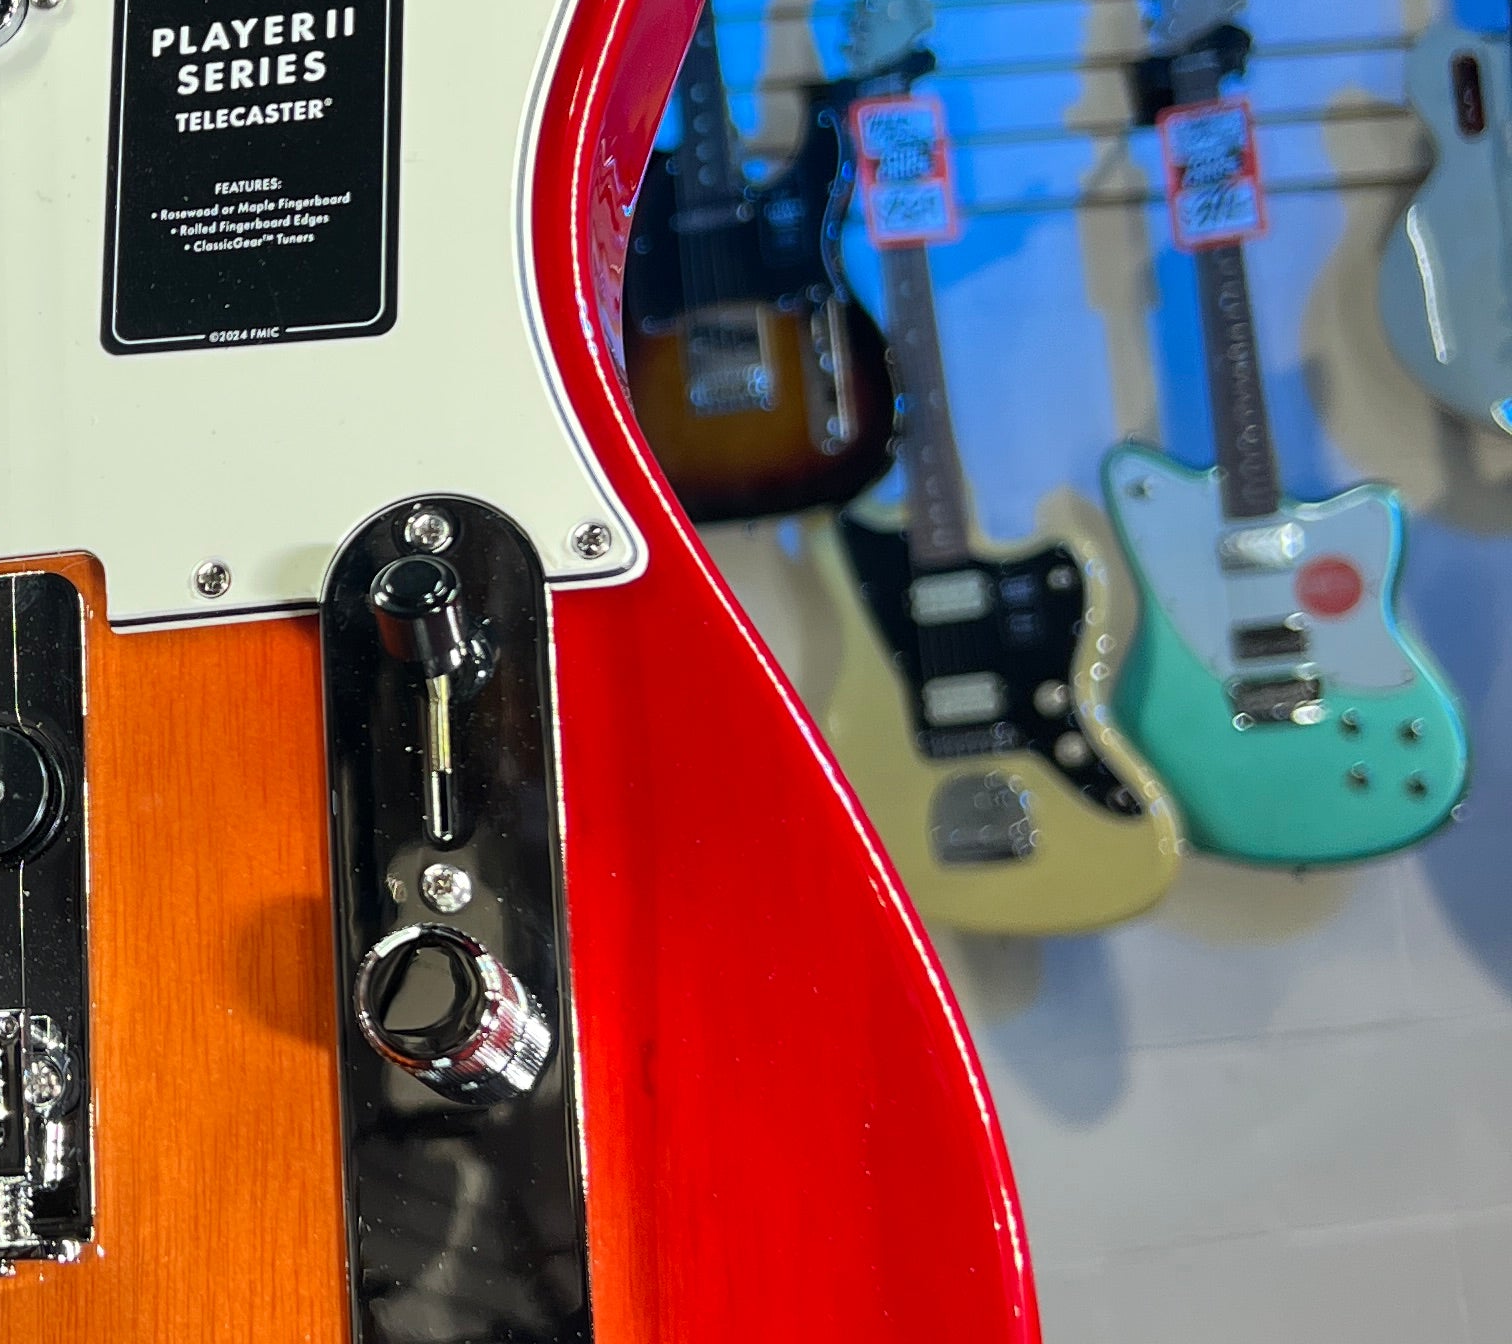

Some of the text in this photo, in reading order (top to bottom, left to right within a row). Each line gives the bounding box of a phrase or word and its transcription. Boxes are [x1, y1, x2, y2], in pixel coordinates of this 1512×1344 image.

[151, 6, 355, 58] PLAYER II
[177, 50, 327, 96] SERIES
[214, 177, 283, 195] FEATURES:
[160, 191, 352, 221] Rosewood or Maple Fingerboard
[179, 213, 330, 237] Rolled Fingerboard Edges
[276, 232, 315, 246] Tuners
[250, 326, 280, 339] FMIC
